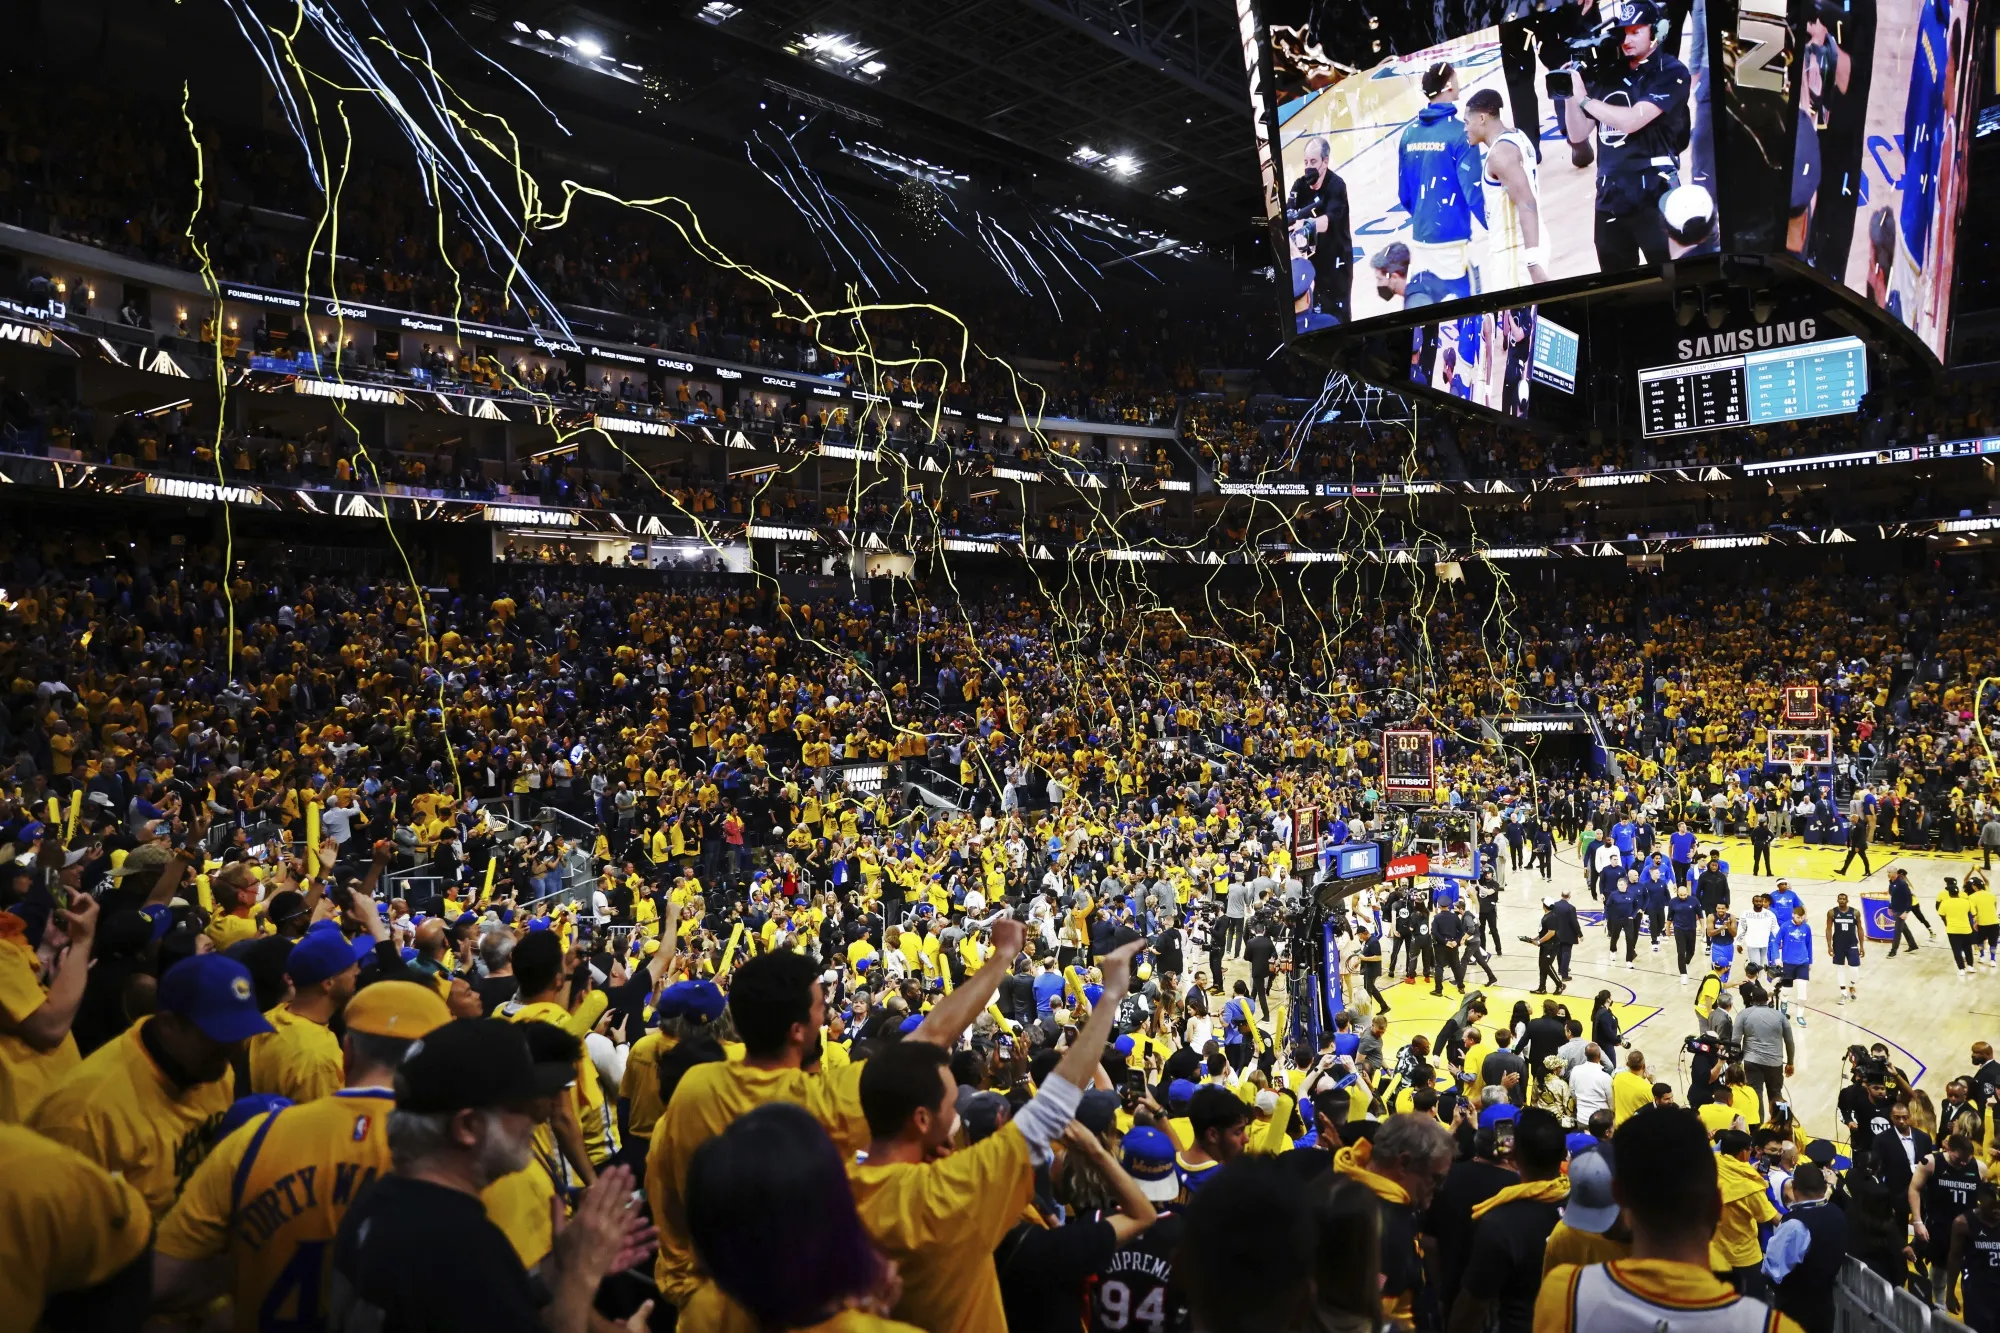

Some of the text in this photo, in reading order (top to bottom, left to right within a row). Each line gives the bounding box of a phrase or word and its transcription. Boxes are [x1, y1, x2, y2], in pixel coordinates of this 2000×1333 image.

[1406, 142, 1446, 152] WARRIORS
[228, 289, 300, 307] FOUNDING PARTNERS
[340, 306, 367, 318] pepsi
[401, 318, 443, 332] RingCentral
[460, 328, 524, 342] UNITED AIRLINES
[1678, 318, 1816, 360] SAMSUNG
[534, 338, 581, 353] Google Cloud
[658, 359, 685, 370] CHASE
[716, 368, 741, 379] Rakuten
[763, 376, 796, 388] ORACLE
[295, 378, 405, 405] WARRIORS WIN
[813, 387, 840, 397] accenture
[977, 412, 1003, 423] ticketmaster
[594, 415, 675, 437] WARRIORS WIN
[819, 444, 855, 460] WARRIORS
[1987, 441, 2000, 451] 117
[992, 467, 1042, 482] WARRIORS WIN
[1578, 474, 1650, 488] WARRIORS WIN
[145, 476, 262, 504] WARRIORS WIN
[1159, 481, 1190, 492] WARRIORS
[1413, 483, 1440, 493] WIN
[484, 505, 580, 526] WARRIORS WIN
[1938, 518, 1991, 532] WARRIORS
[745, 526, 818, 541] WARRIORS WIN
[943, 540, 999, 553] WARRIORS WIN
[1693, 536, 1769, 549] WARRIORS WIN
[1107, 549, 1165, 561] WARRIORS WIN
[1285, 551, 1348, 563] WARRIORS WIN
[1480, 548, 1547, 559] WARRIORS WIN
[1795, 690, 1808, 698] 0.0
[1501, 722, 1574, 732] WARRIORS WIN
[1400, 737, 1419, 750] 0.0
[843, 766, 888, 782] WARRIORS
[1402, 778, 1430, 786] TISSOT
[1329, 977, 1336, 999] TV
[1938, 1178, 1977, 1190] MAVERICKS
[1950, 1190, 1966, 1204] 77
[1100, 1280, 1166, 1333] 94
